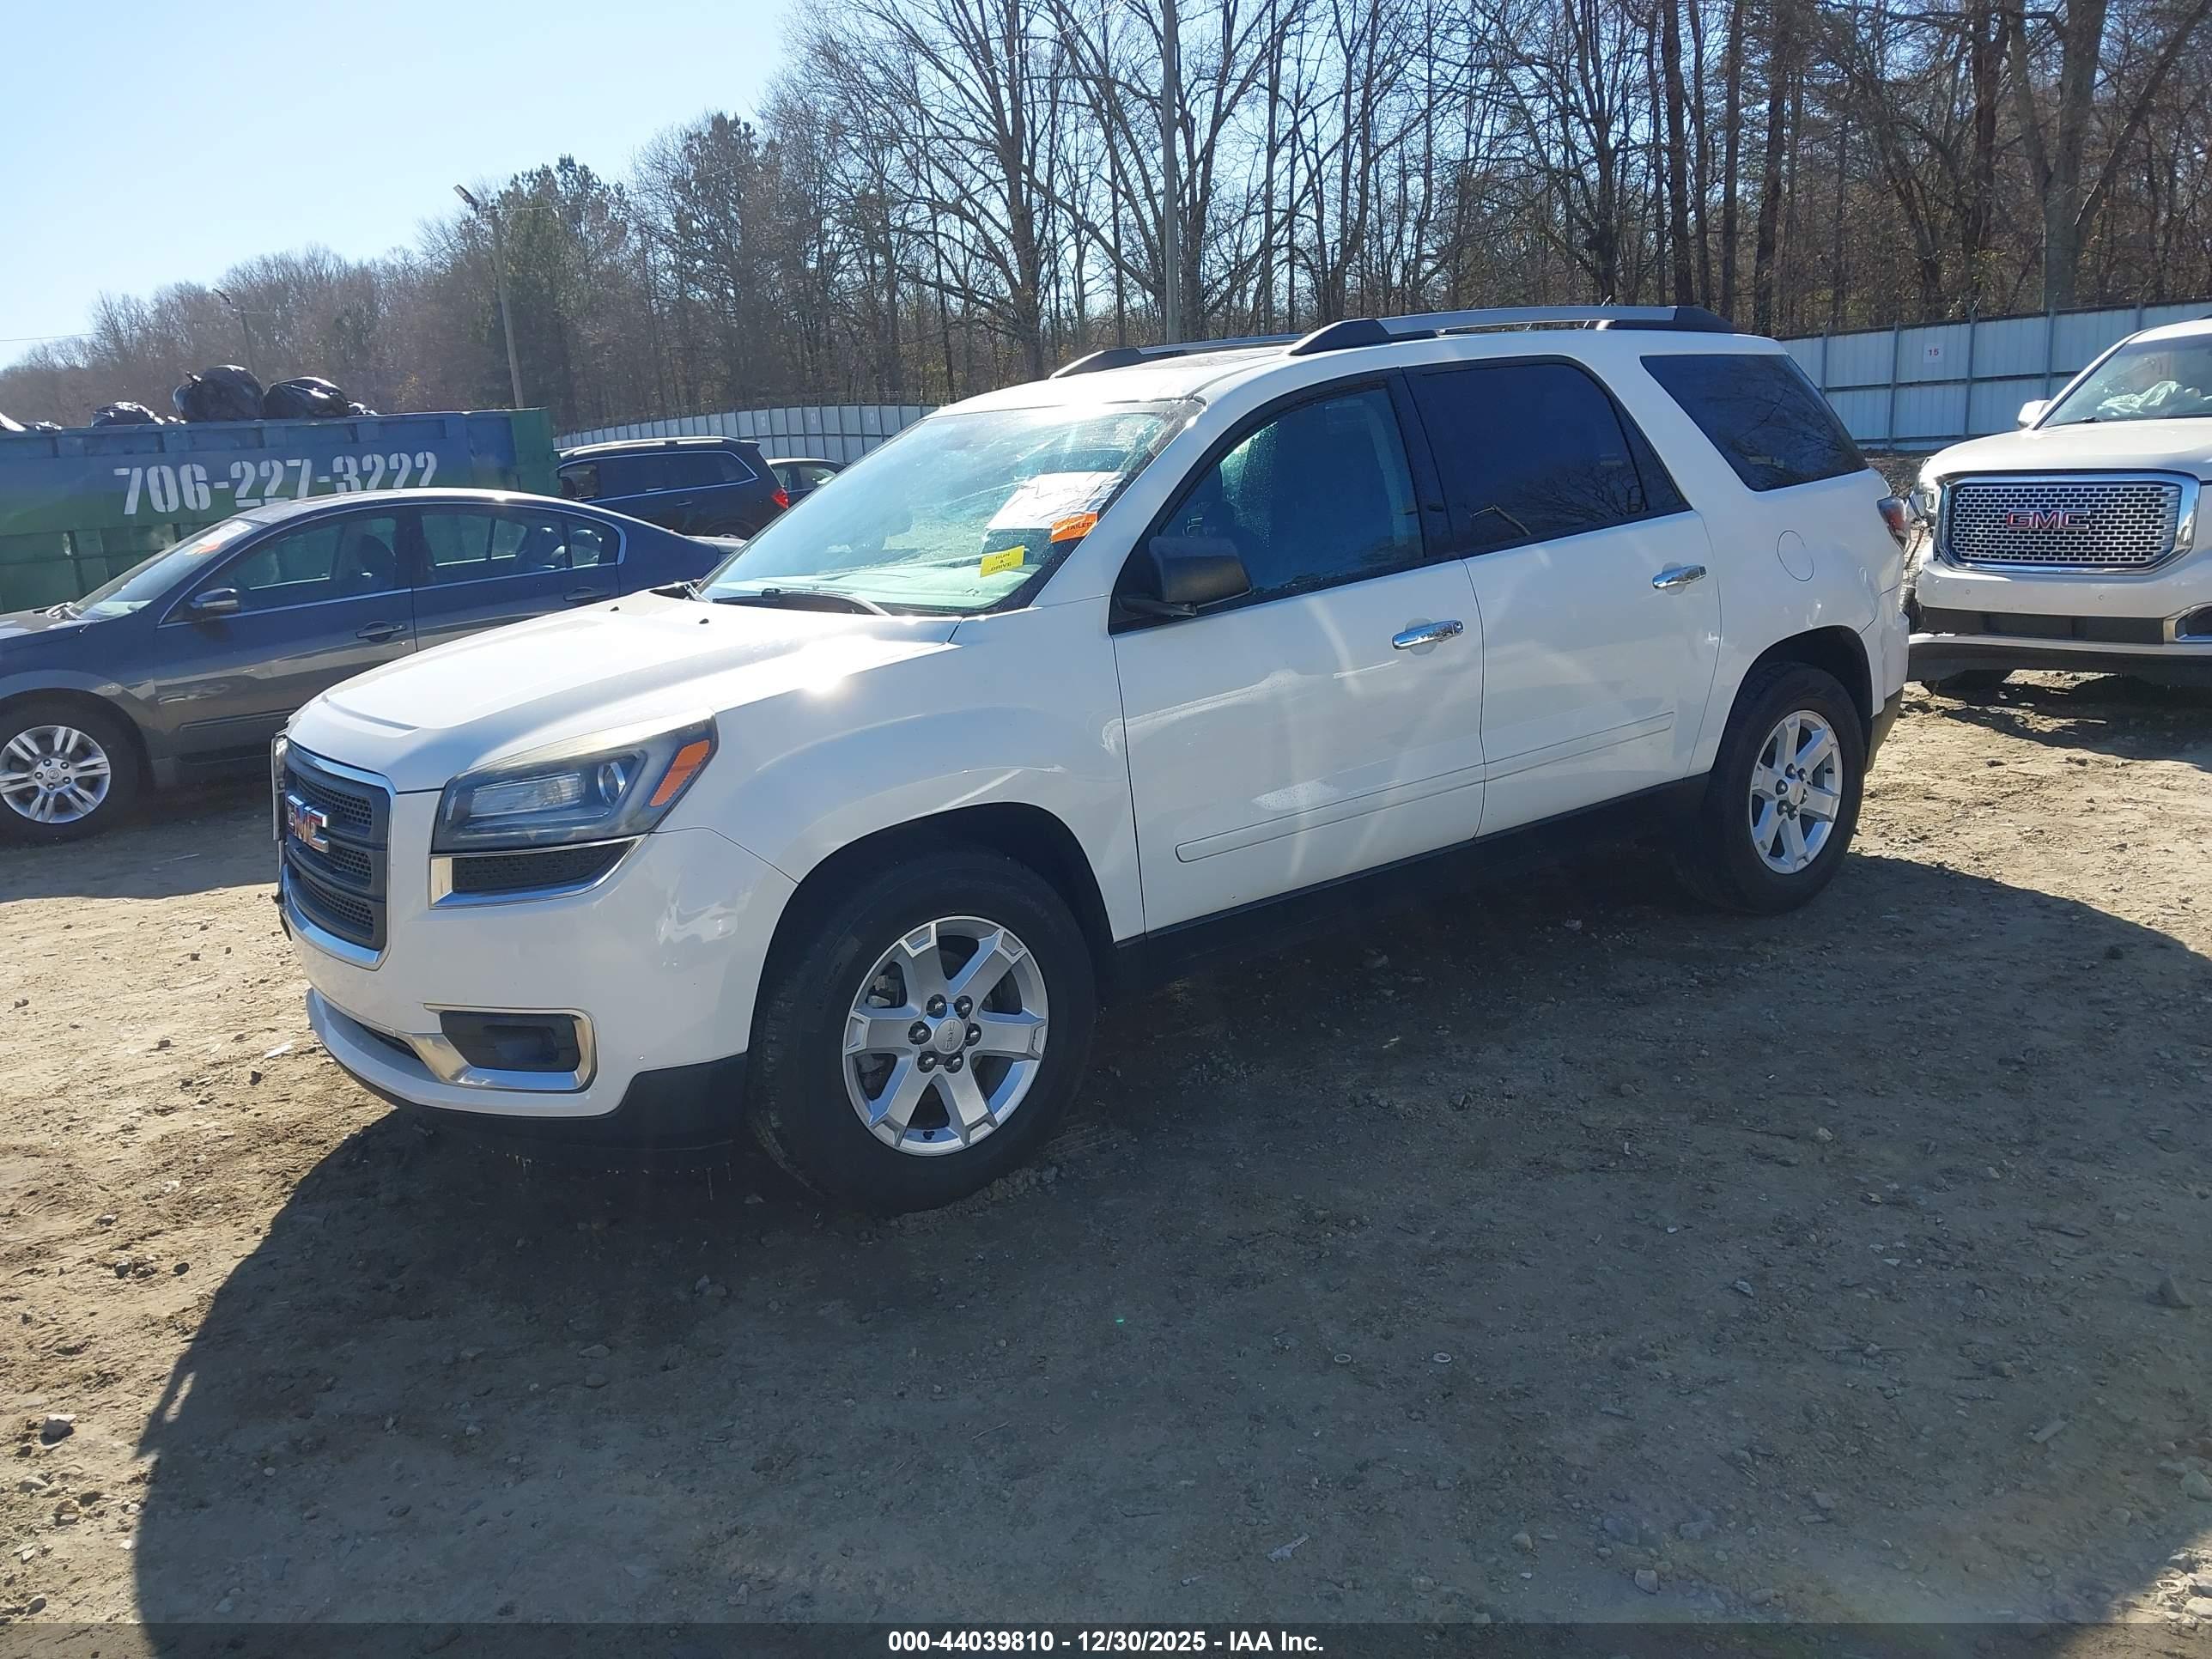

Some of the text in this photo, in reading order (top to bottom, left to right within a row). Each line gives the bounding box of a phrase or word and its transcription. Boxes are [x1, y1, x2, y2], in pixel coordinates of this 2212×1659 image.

[113, 451, 437, 515] 706-227-3222
[2007, 509, 2092, 530] GMC
[990, 562, 1012, 571] DRIVE
[287, 795, 329, 854] GMC
